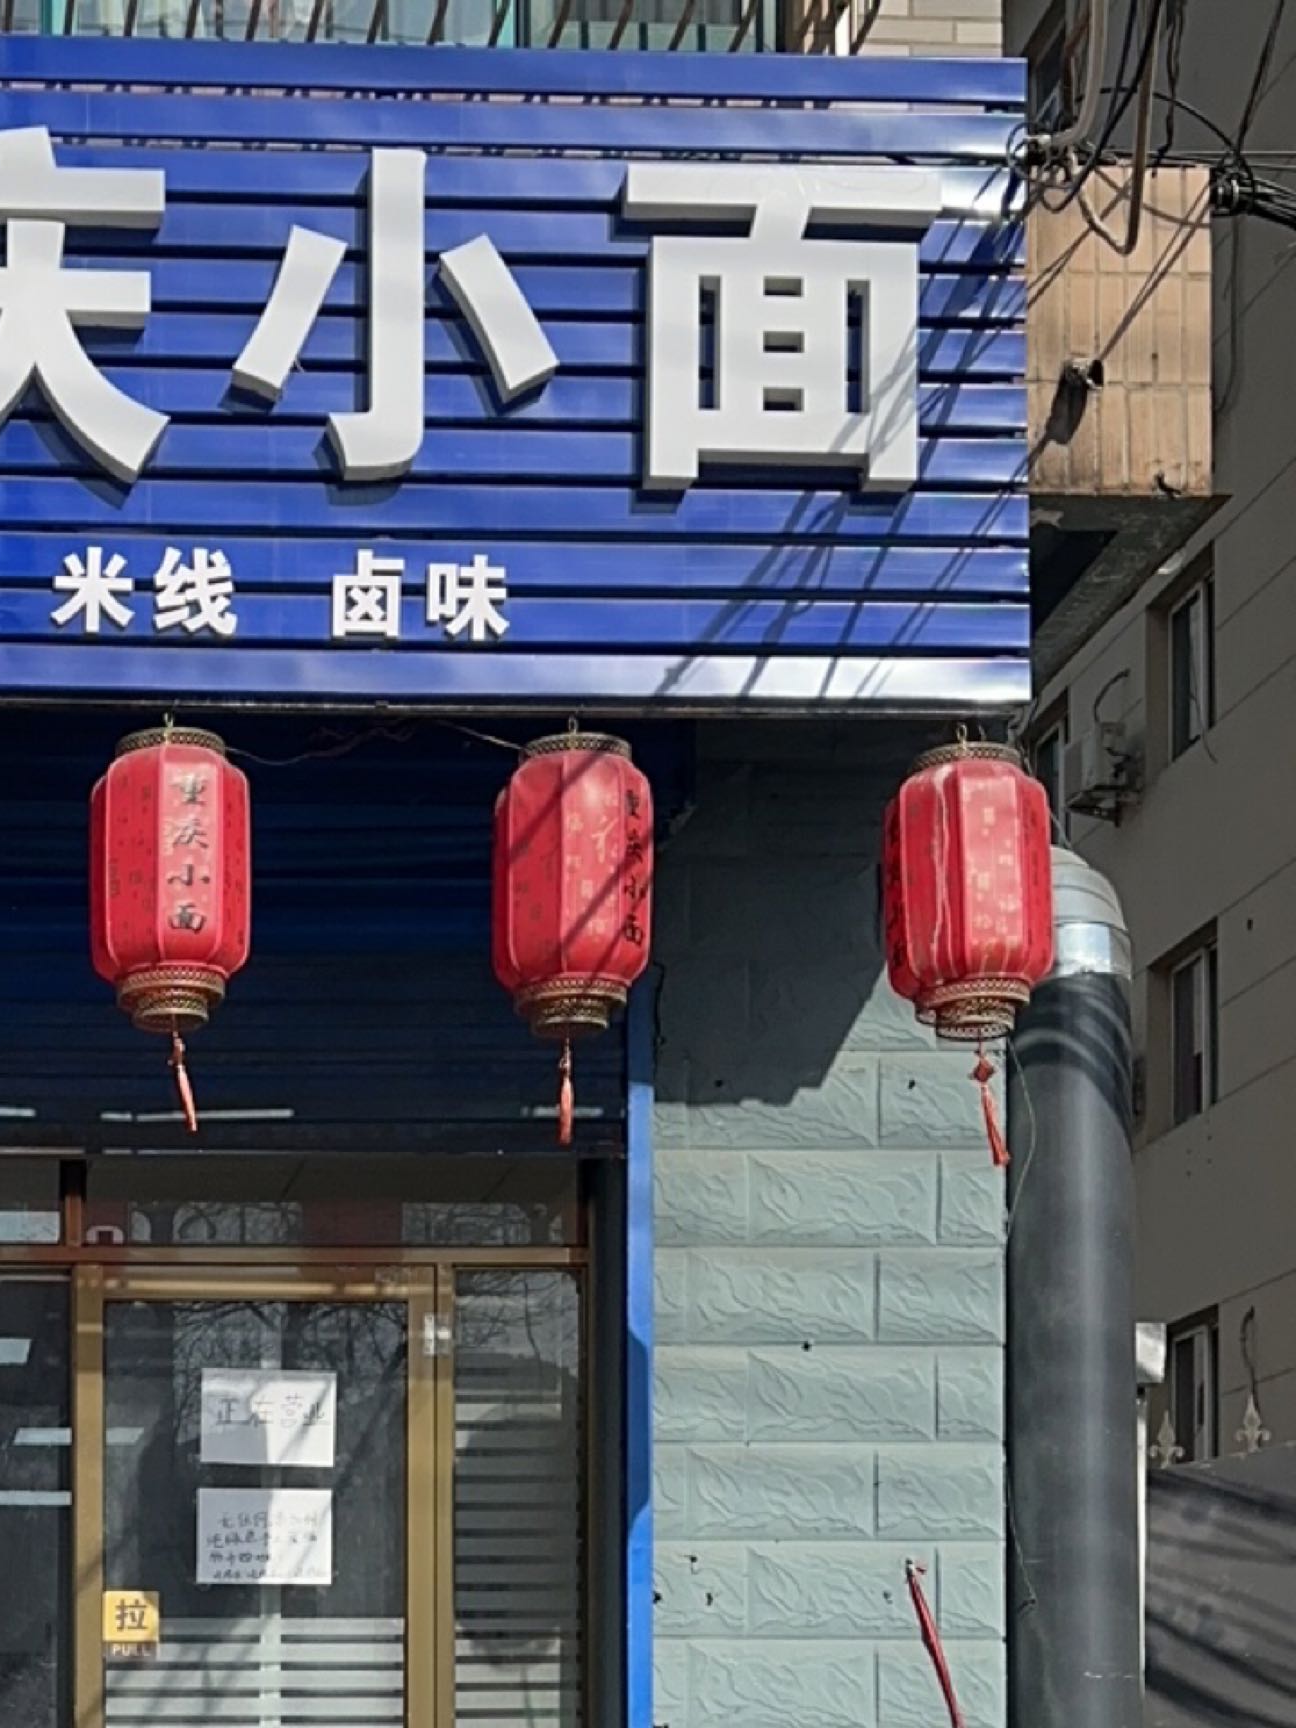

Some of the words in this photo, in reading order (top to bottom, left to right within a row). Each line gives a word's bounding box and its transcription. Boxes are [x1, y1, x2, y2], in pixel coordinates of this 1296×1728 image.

[50, 546, 237, 637] 米线
[332, 549, 510, 640] 卤味
[114, 1598, 149, 1632] 拉
